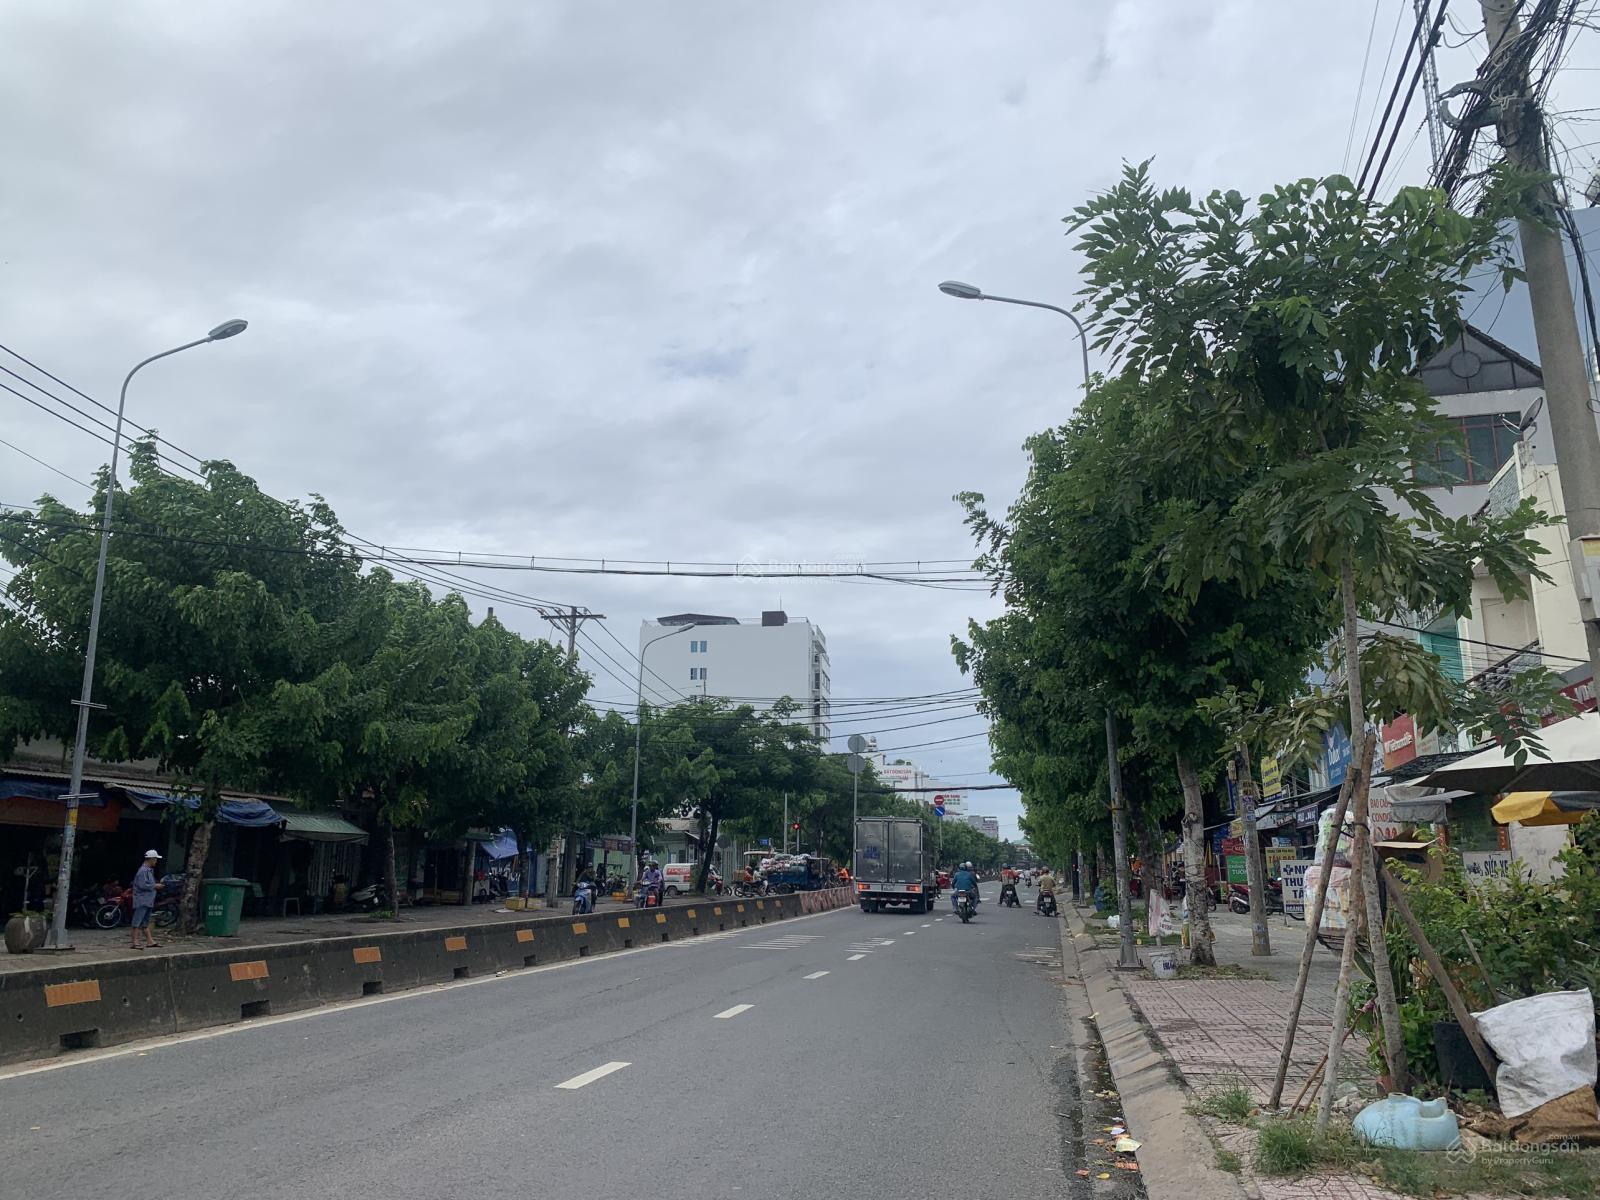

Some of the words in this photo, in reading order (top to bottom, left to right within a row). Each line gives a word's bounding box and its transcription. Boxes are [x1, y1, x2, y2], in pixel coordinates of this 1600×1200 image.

[1295, 865, 1308, 875] NH
[1284, 878, 1303, 886] THU
[1292, 888, 1304, 899] TÂ
